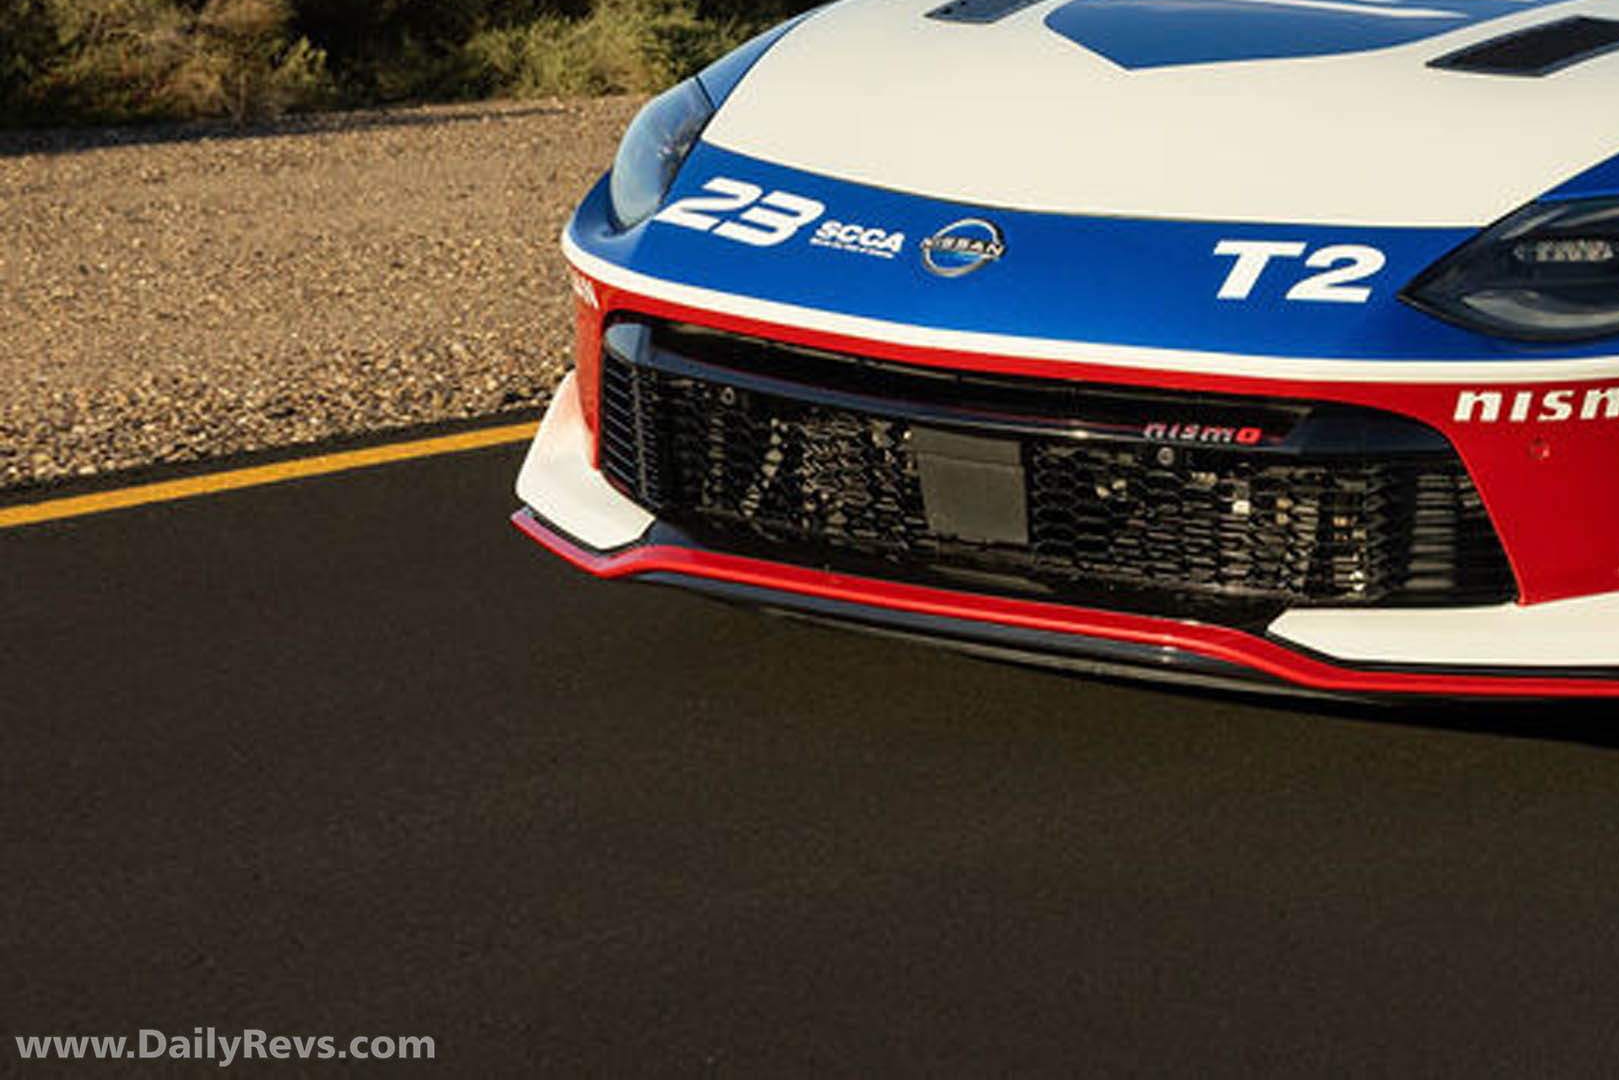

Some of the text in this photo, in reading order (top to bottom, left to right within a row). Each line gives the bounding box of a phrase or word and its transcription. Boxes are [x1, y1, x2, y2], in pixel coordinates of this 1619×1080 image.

[653, 176, 827, 247] 23
[814, 220, 905, 254] SCCA
[920, 236, 1004, 257] NISSAN
[1213, 240, 1387, 304] T2
